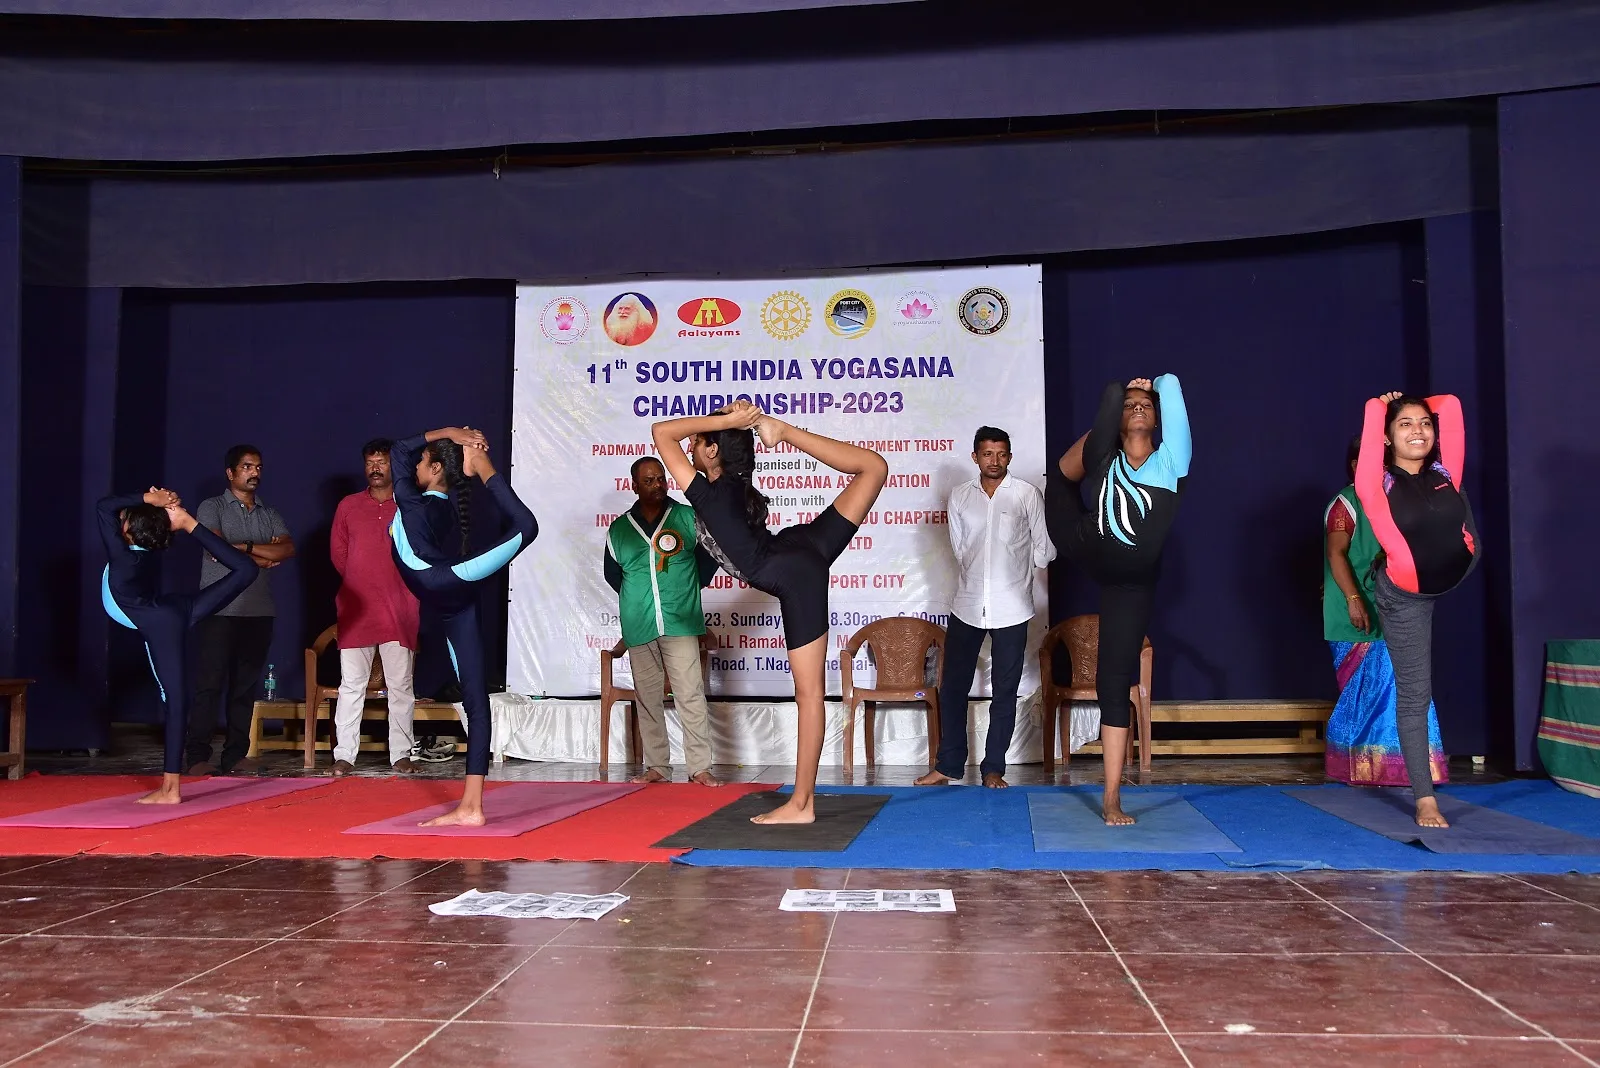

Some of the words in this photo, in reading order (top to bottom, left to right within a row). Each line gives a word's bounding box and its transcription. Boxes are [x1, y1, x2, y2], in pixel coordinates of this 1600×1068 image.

[677, 329, 741, 338] Aalayams
[635, 361, 722, 384] SOUTH
[732, 359, 803, 381] INDIA
[811, 356, 955, 380] YOGASANA
[592, 444, 646, 456] PADMAM
[914, 439, 955, 451] TRUST
[755, 460, 801, 473] ganised
[805, 459, 818, 472] by
[757, 475, 832, 490] YOGASANA
[801, 495, 825, 506] with
[884, 511, 949, 525] CHAPTER
[848, 536, 873, 550] LTD
[830, 574, 868, 589] PORT
[873, 574, 906, 588] CITY
[711, 656, 750, 673] Road,
